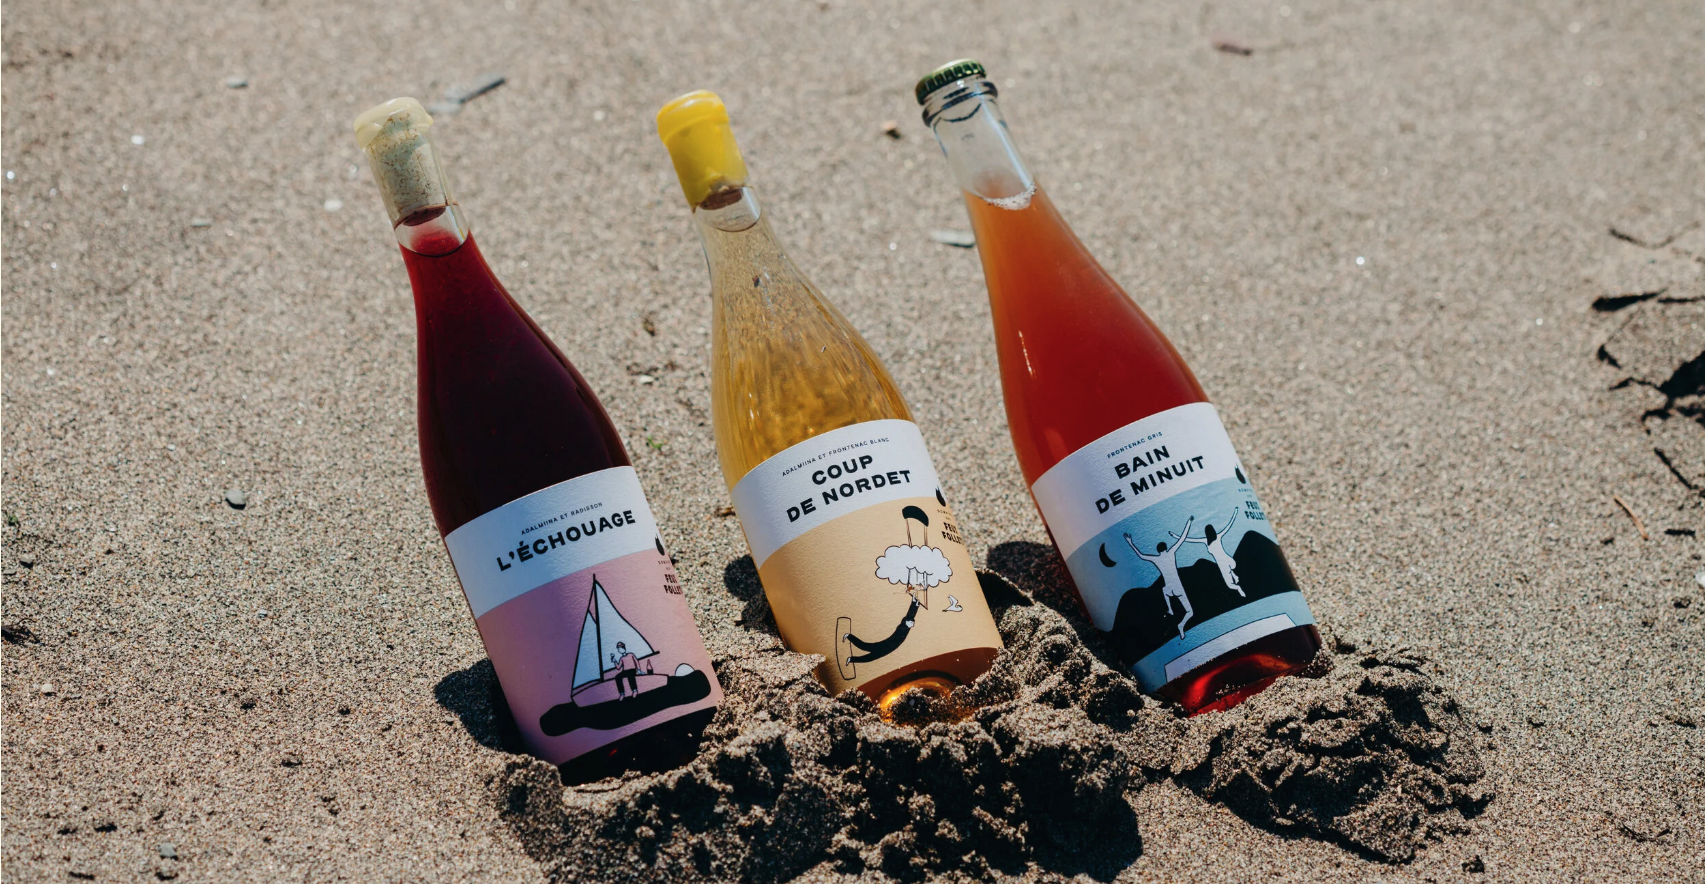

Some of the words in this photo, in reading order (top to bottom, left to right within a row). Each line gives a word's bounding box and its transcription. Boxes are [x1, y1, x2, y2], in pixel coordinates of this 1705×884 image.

[782, 457, 816, 477] ADALMIINA
[828, 441, 868, 456] FRONTENAC
[870, 437, 890, 445] BLANC
[1107, 438, 1145, 459] FRONTENAC
[1147, 431, 1163, 441] GRIS
[1114, 445, 1170, 479] BAIN
[811, 455, 873, 485] COUP
[1095, 488, 1126, 515] DE
[1130, 455, 1204, 496] MINUIT
[786, 498, 817, 523] DE
[821, 470, 911, 505] NORDET
[521, 517, 559, 536] ADALMIINA
[560, 512, 568, 520] ET
[570, 502, 603, 516] RADISSON
[496, 509, 636, 572] L’ÉCHOUAGE
